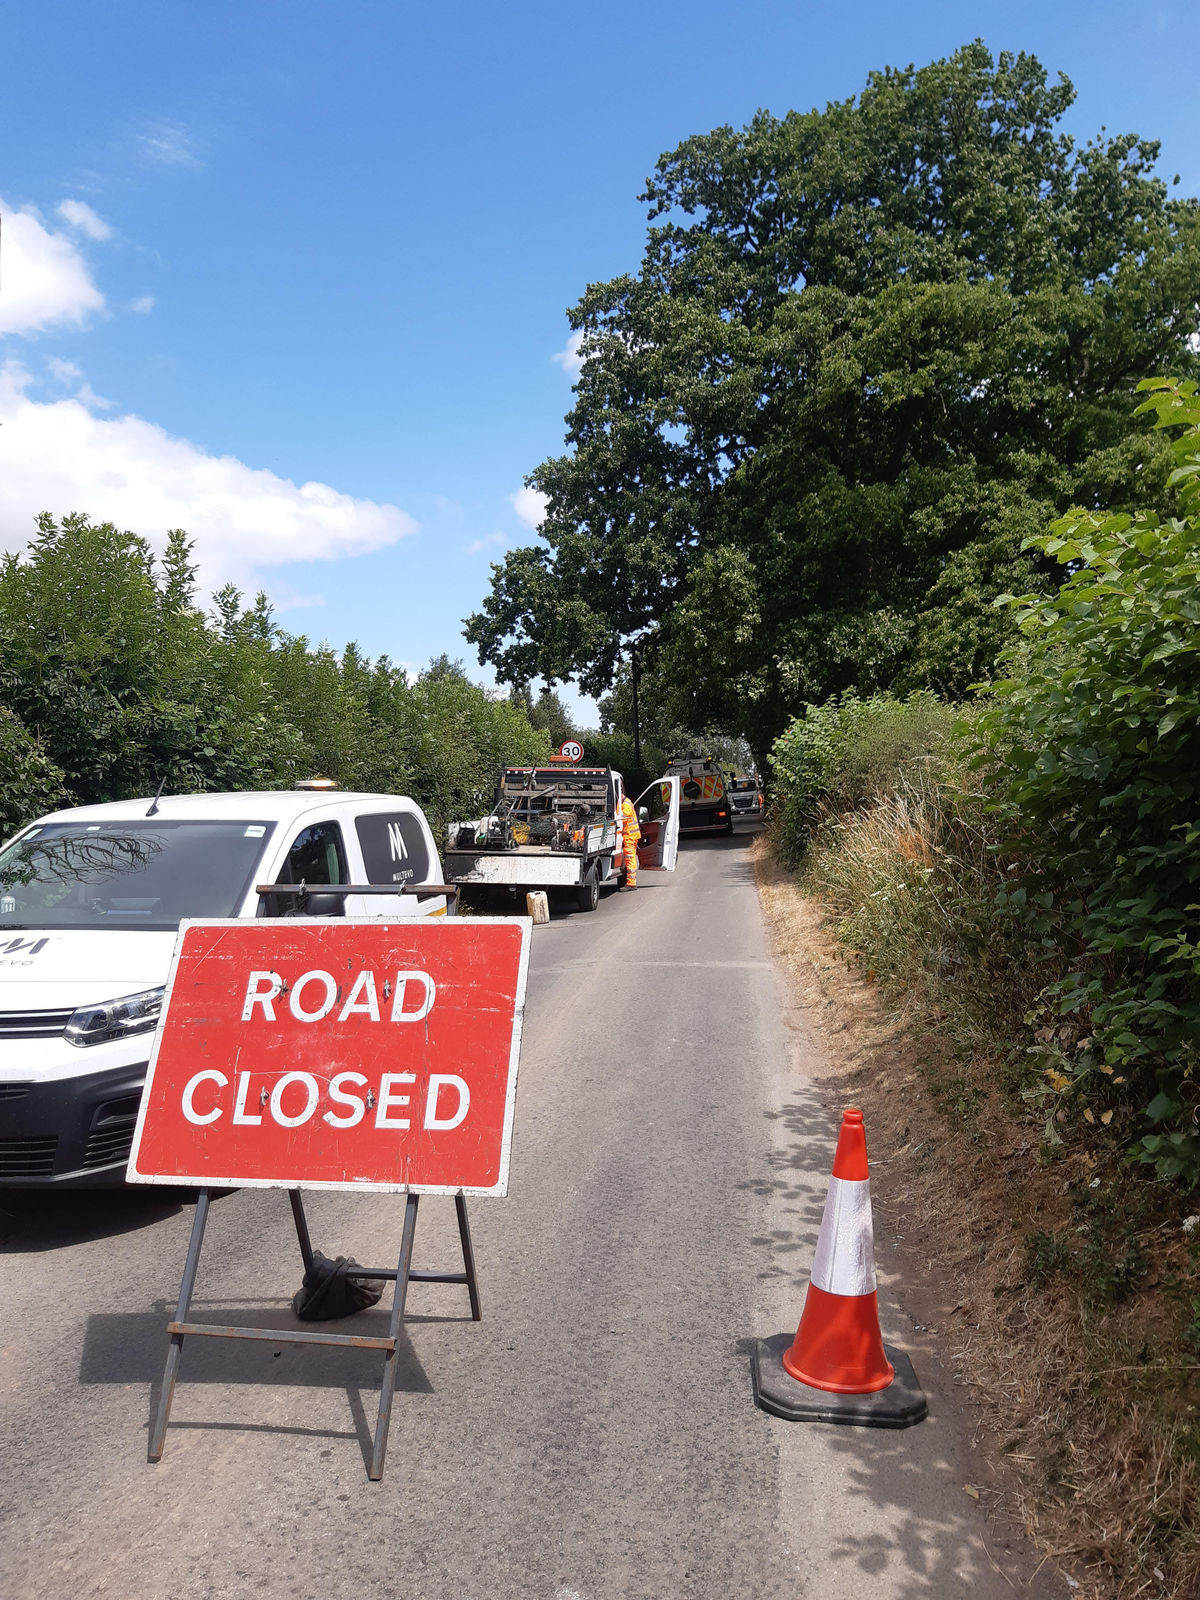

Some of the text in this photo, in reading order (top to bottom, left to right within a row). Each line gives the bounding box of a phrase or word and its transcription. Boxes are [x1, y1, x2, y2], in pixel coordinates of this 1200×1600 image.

[563, 746, 580, 756] 30
[392, 868, 414, 882] MULTEVO
[241, 969, 437, 1023] ROAD
[181, 1069, 471, 1131] CLOSED
